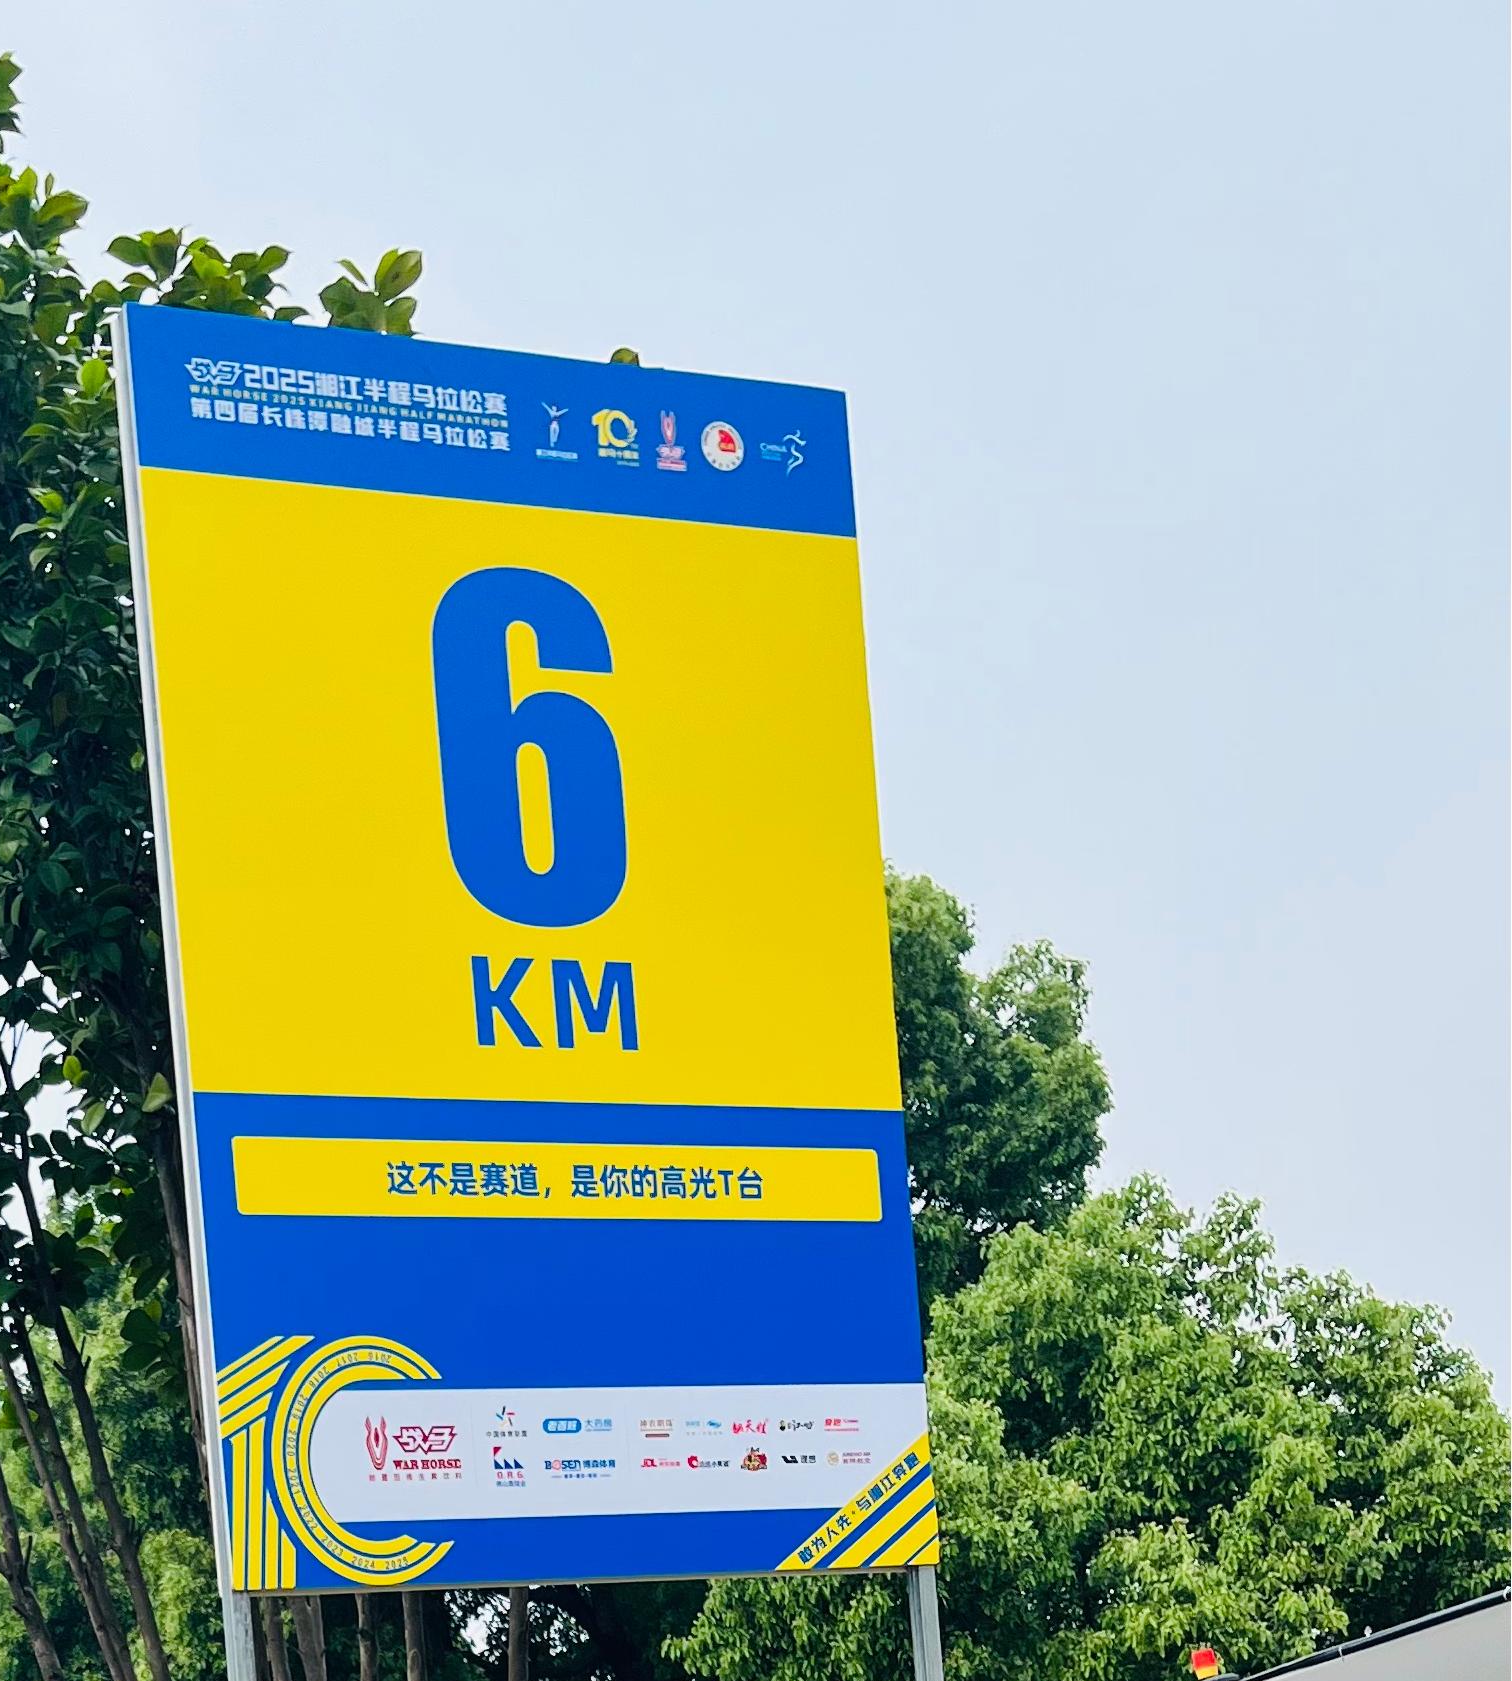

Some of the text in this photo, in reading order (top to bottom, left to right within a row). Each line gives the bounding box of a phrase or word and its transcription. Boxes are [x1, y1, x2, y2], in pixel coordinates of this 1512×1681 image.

[430, 565, 629, 929] 6
[470, 955, 639, 1052] KM
[387, 1161, 764, 1200] 这不是赛道，是你的高光T台
[393, 1459, 462, 1470] WAR HORSE
